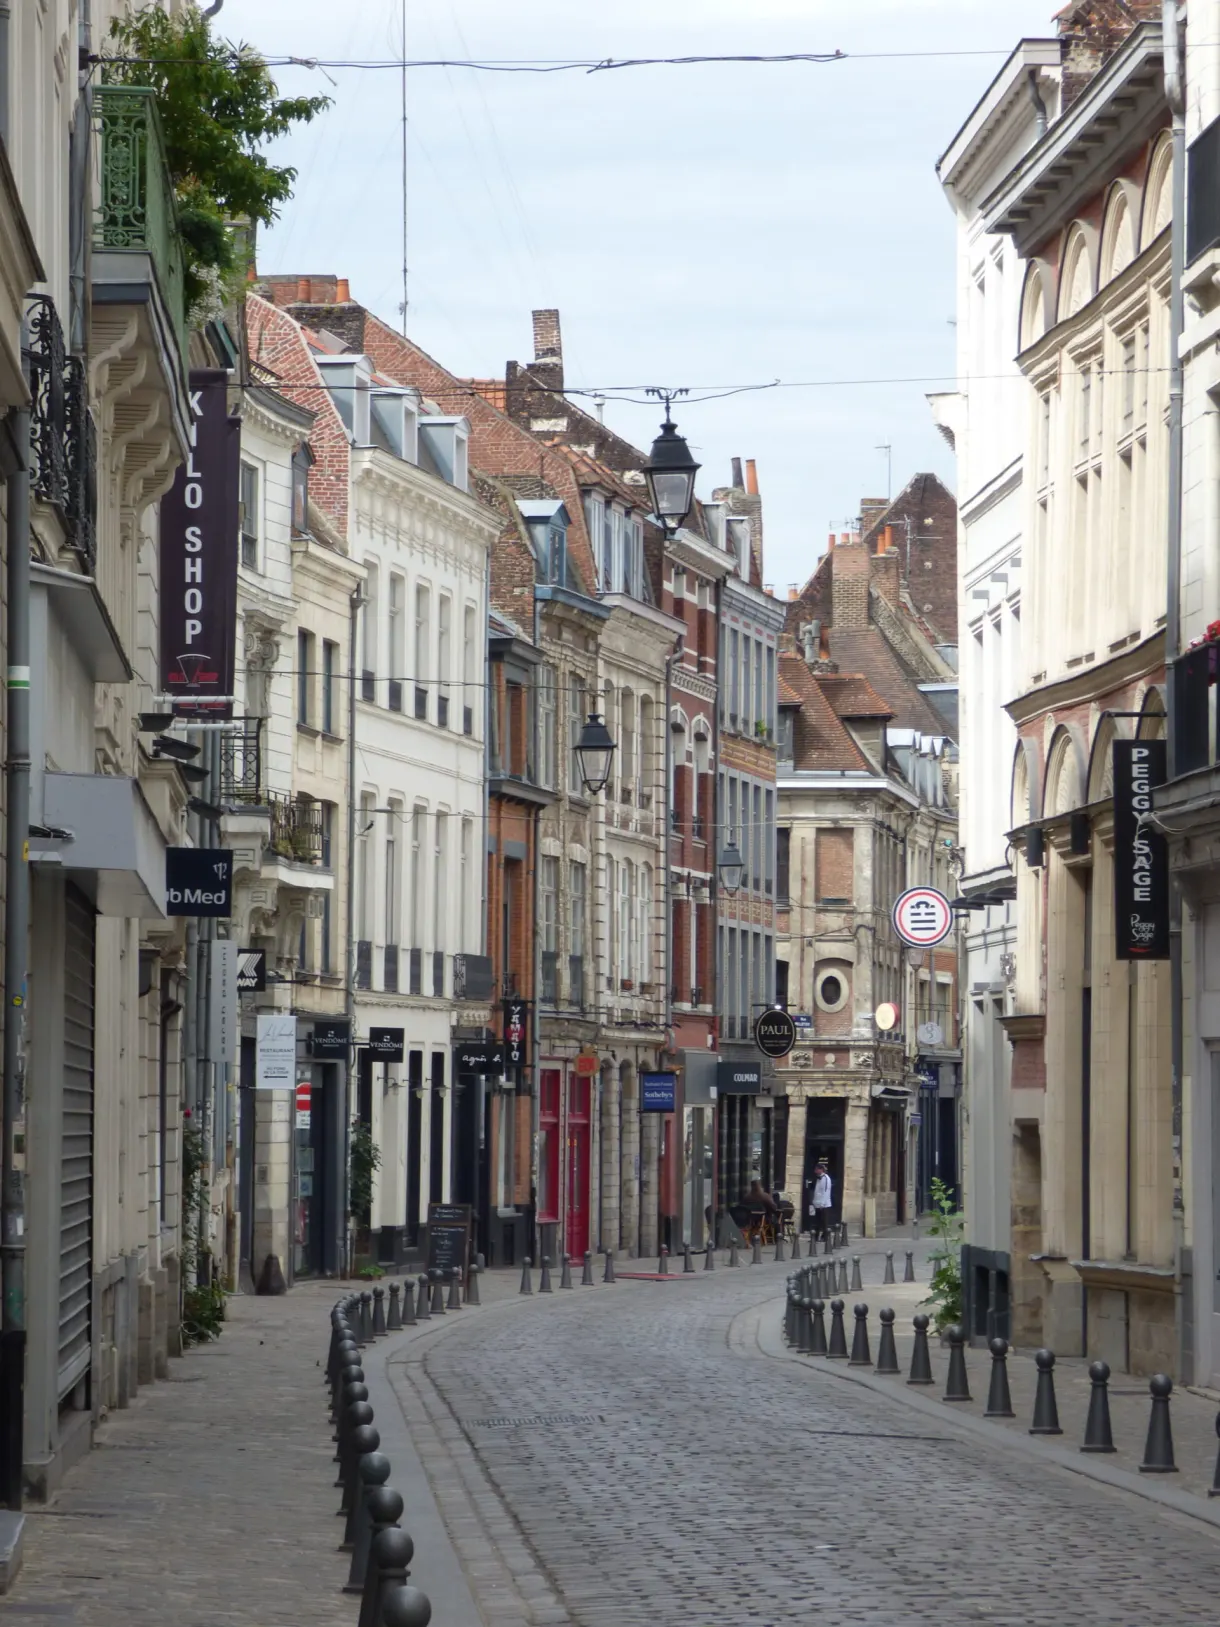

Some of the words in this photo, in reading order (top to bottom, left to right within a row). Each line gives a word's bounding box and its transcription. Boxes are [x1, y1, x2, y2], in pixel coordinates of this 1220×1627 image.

[185, 391, 204, 509] KILO
[184, 526, 204, 645] SHOP
[1131, 748, 1150, 825] PEGGY
[1132, 840, 1152, 901] SAGE
[184, 888, 227, 905] Med
[1130, 913, 1155, 932] Peggy
[1131, 928, 1154, 942] Sage
[510, 1006, 521, 1061] YAMATO
[760, 1025, 791, 1035] PAUL
[370, 1041, 404, 1049] VENDÔME
[462, 1054, 487, 1067] agnès
[733, 1073, 758, 1082] COLMAR
[644, 1091, 673, 1100] Sotheby's
